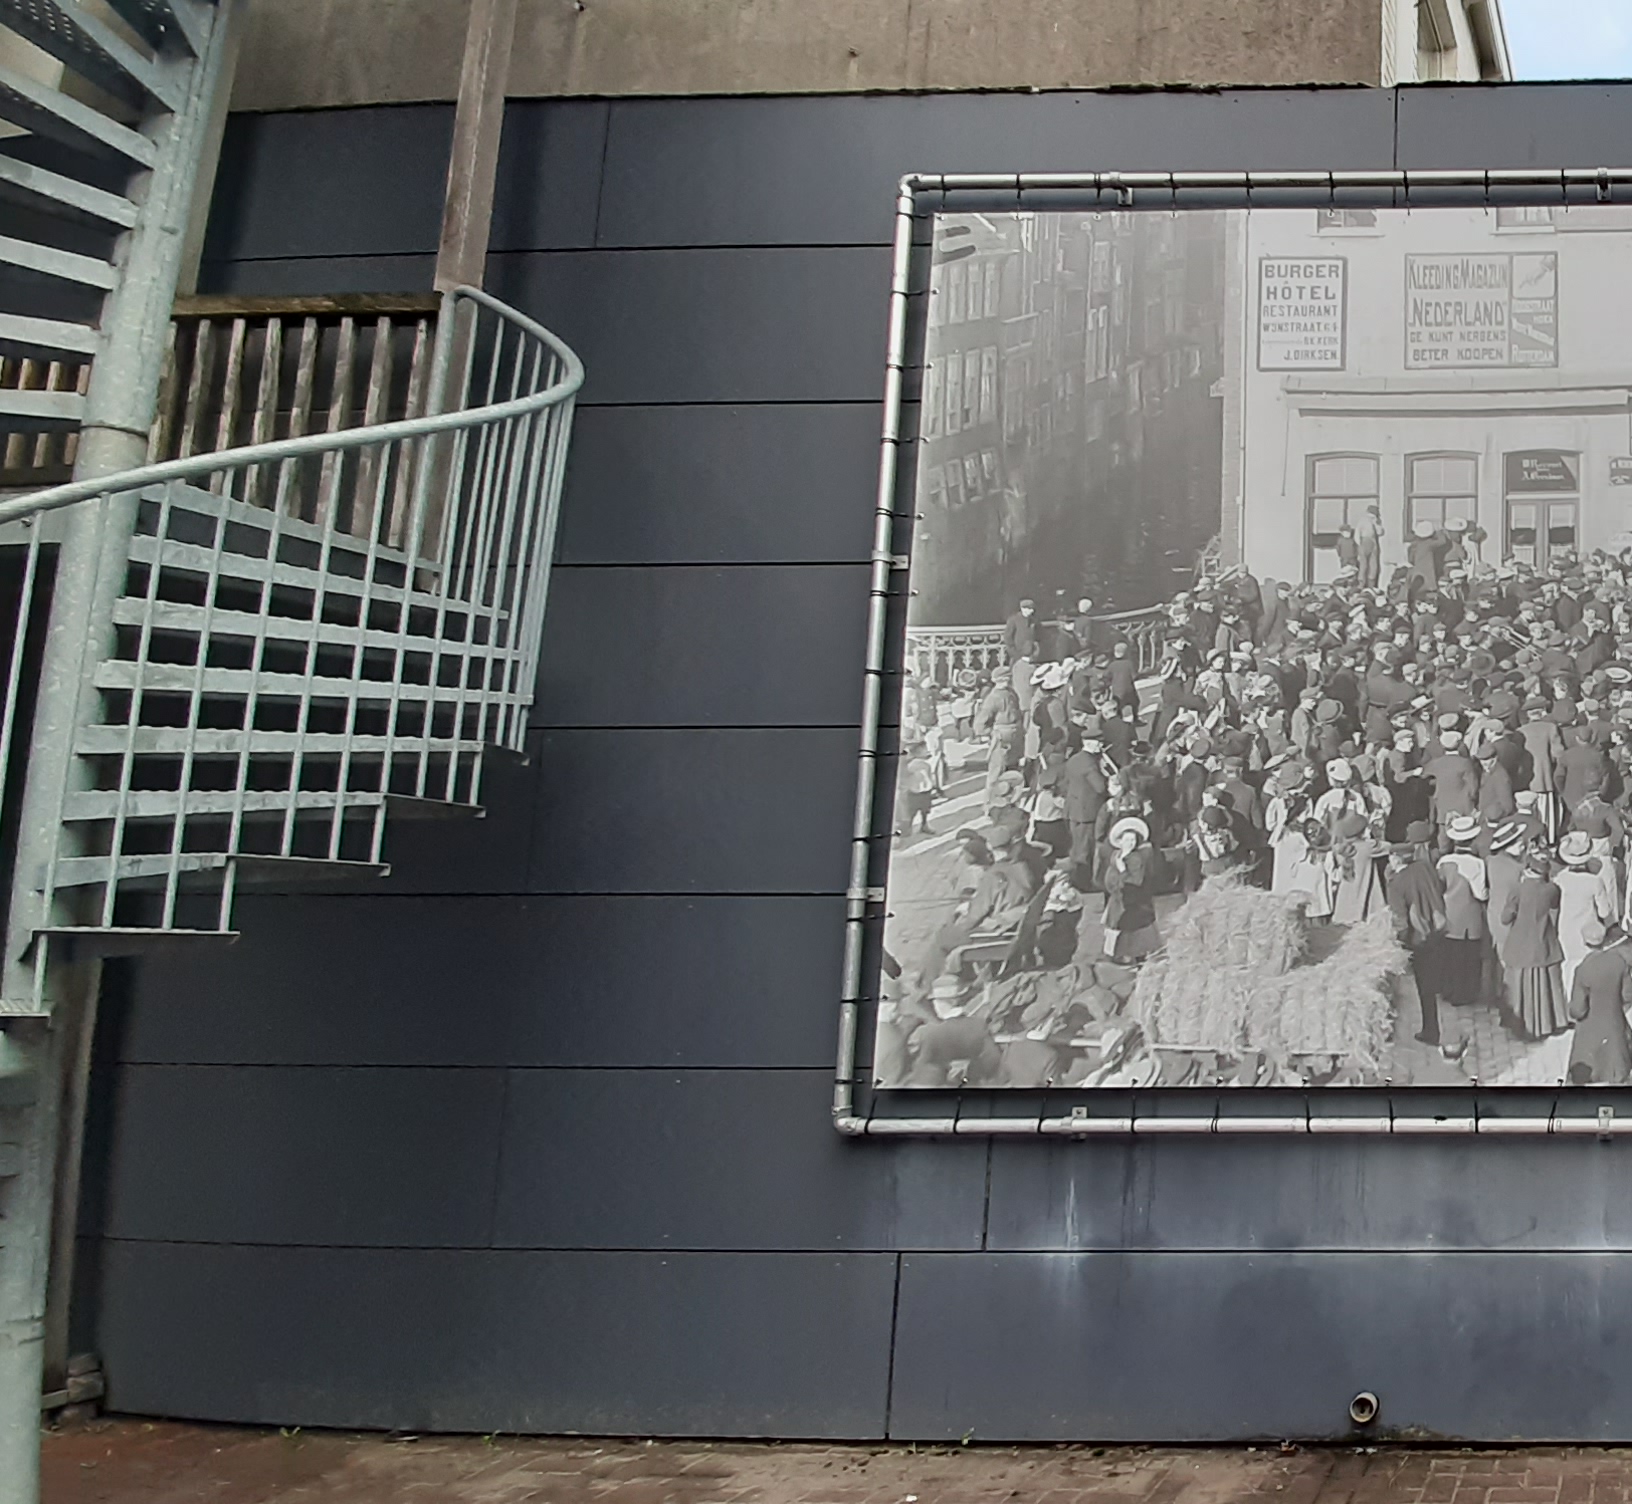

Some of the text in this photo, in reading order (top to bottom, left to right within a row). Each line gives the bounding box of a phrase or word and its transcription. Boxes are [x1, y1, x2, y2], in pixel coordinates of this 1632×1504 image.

[1264, 264, 1340, 279] BURGER
[1262, 303, 1339, 318] RESTAURANT
[1409, 331, 1422, 343] GE
[1428, 330, 1454, 343] KUNT
[1459, 329, 1507, 342] NERGENS
[1412, 347, 1504, 362] BETER KOOPEN
